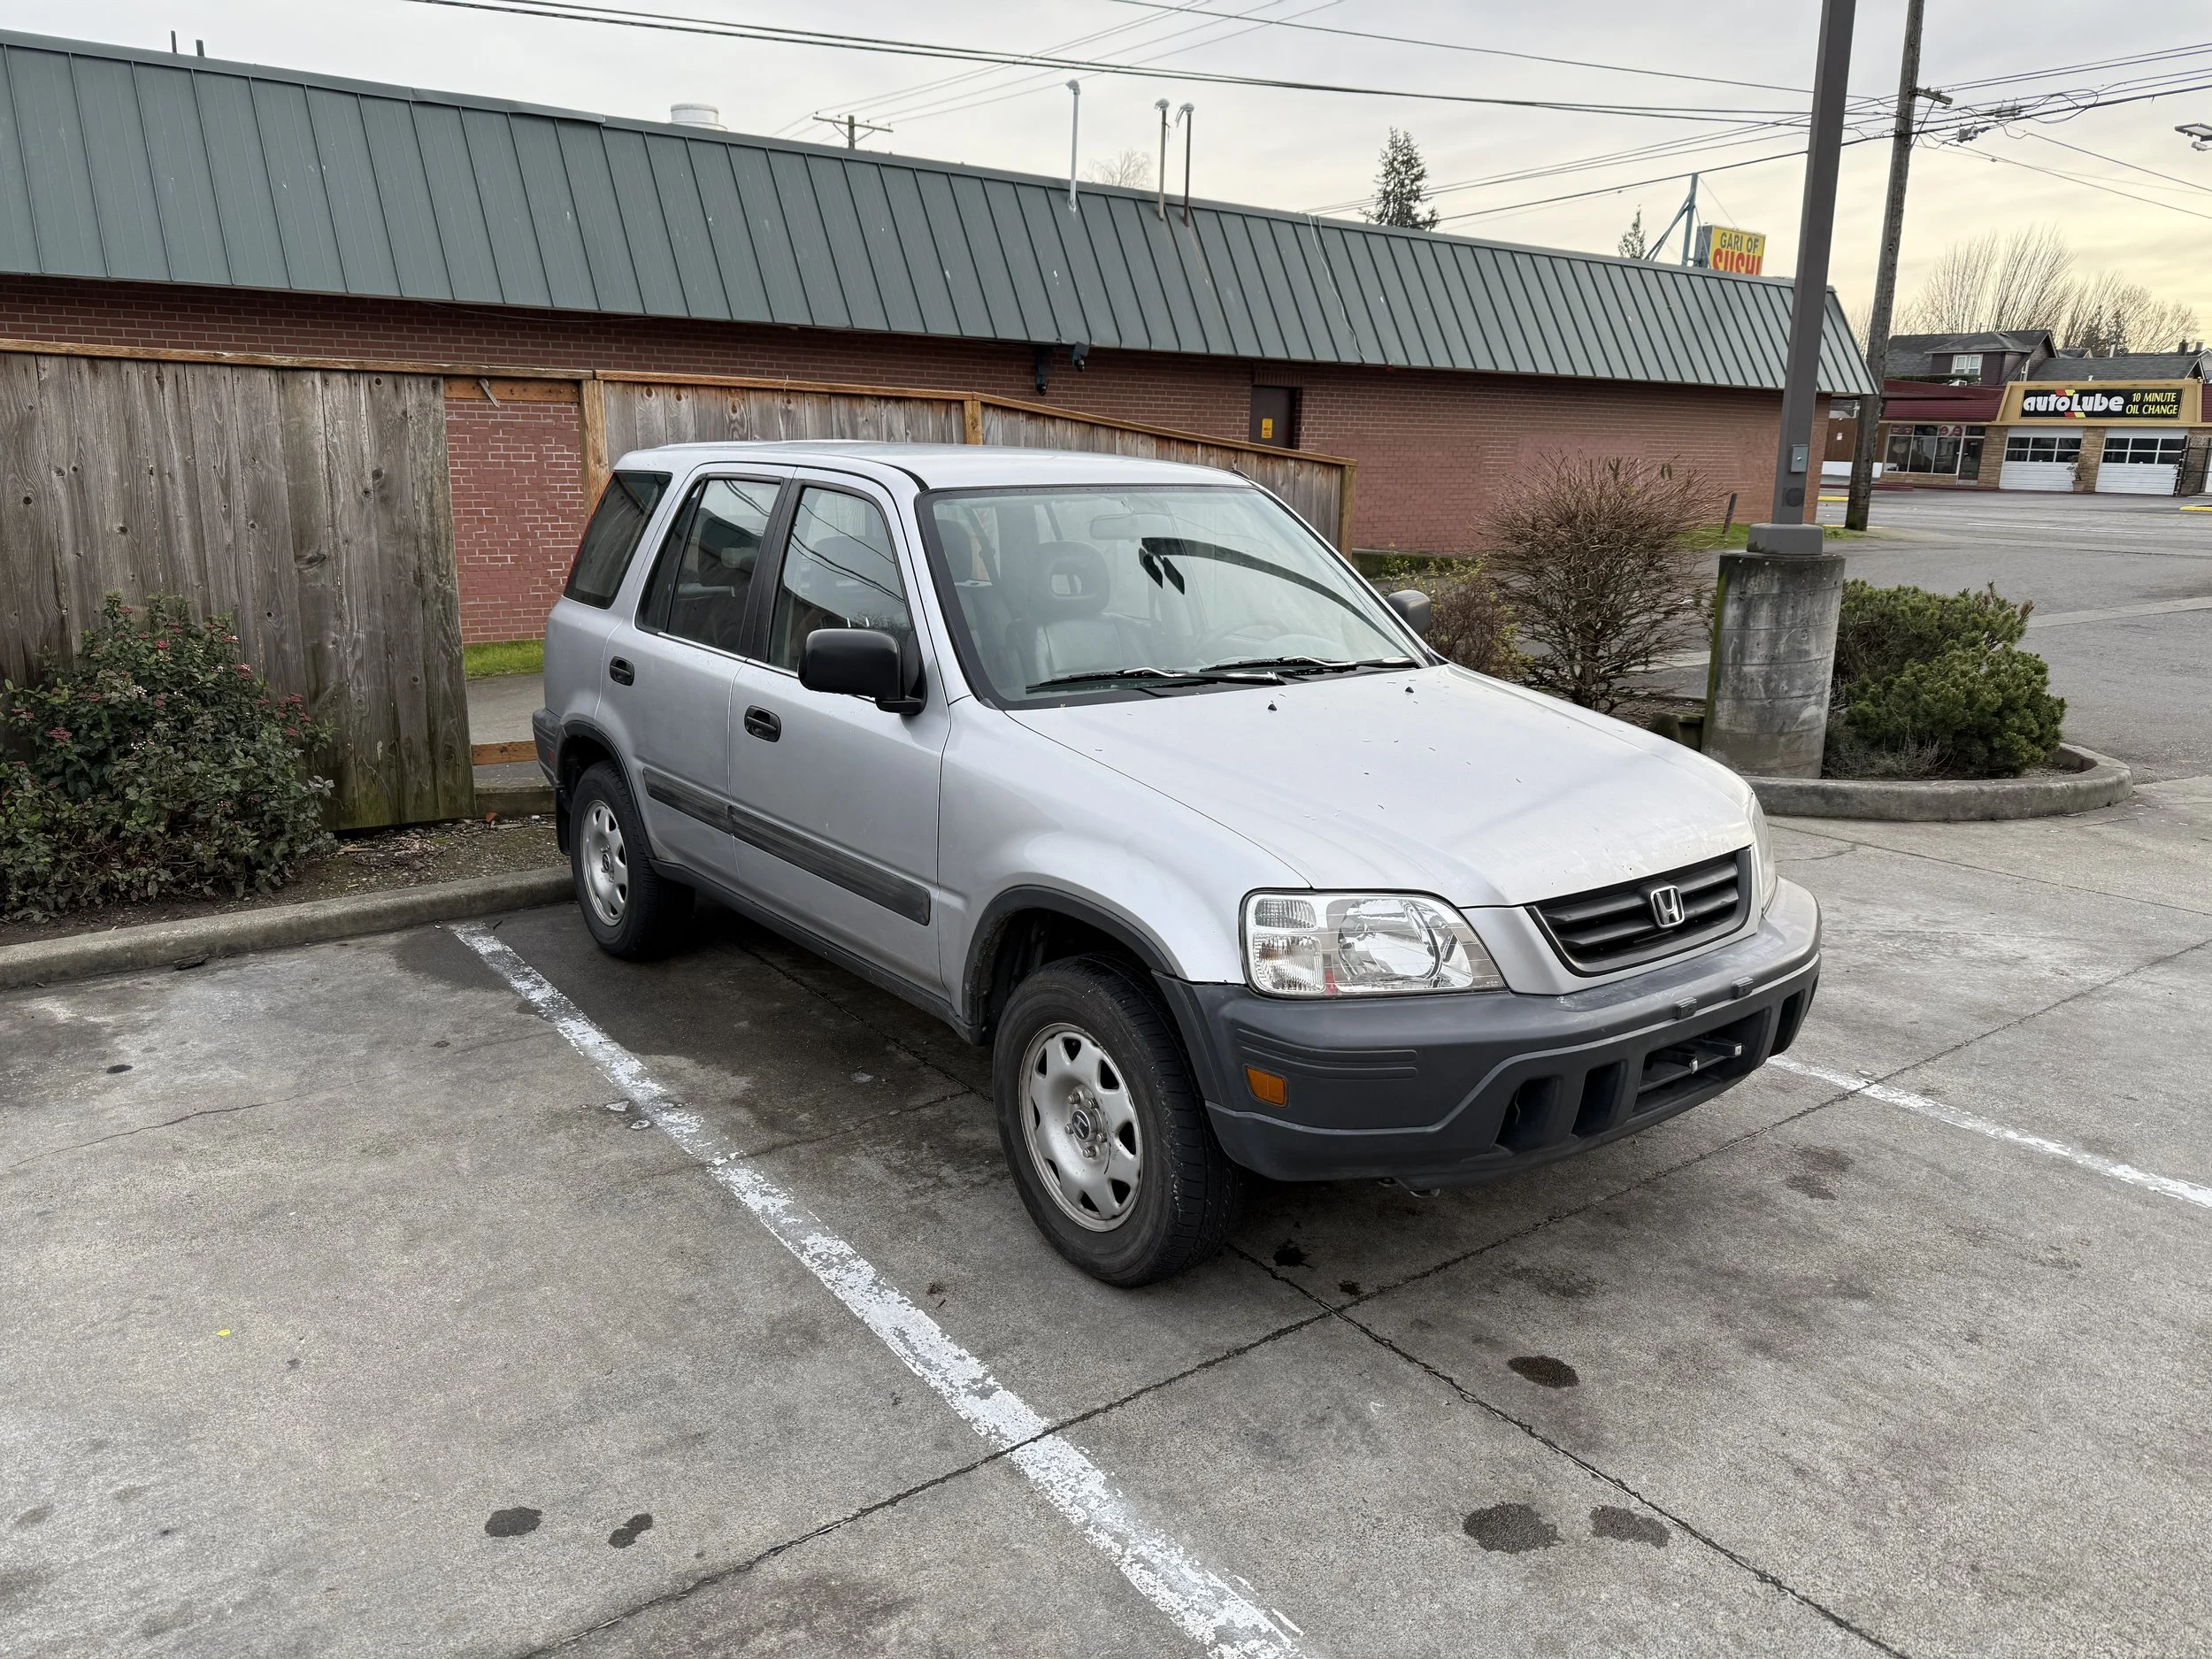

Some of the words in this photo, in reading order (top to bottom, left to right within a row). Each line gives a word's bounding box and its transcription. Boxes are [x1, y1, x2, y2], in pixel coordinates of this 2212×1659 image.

[1720, 232, 1743, 250] GARI
[1747, 237, 1759, 254] OF
[2023, 393, 2124, 412] autoLube
[2131, 392, 2141, 402] 10
[2143, 392, 2177, 403] MINUTE
[2125, 403, 2139, 414] OIL
[2142, 403, 2178, 415] CHANGE
